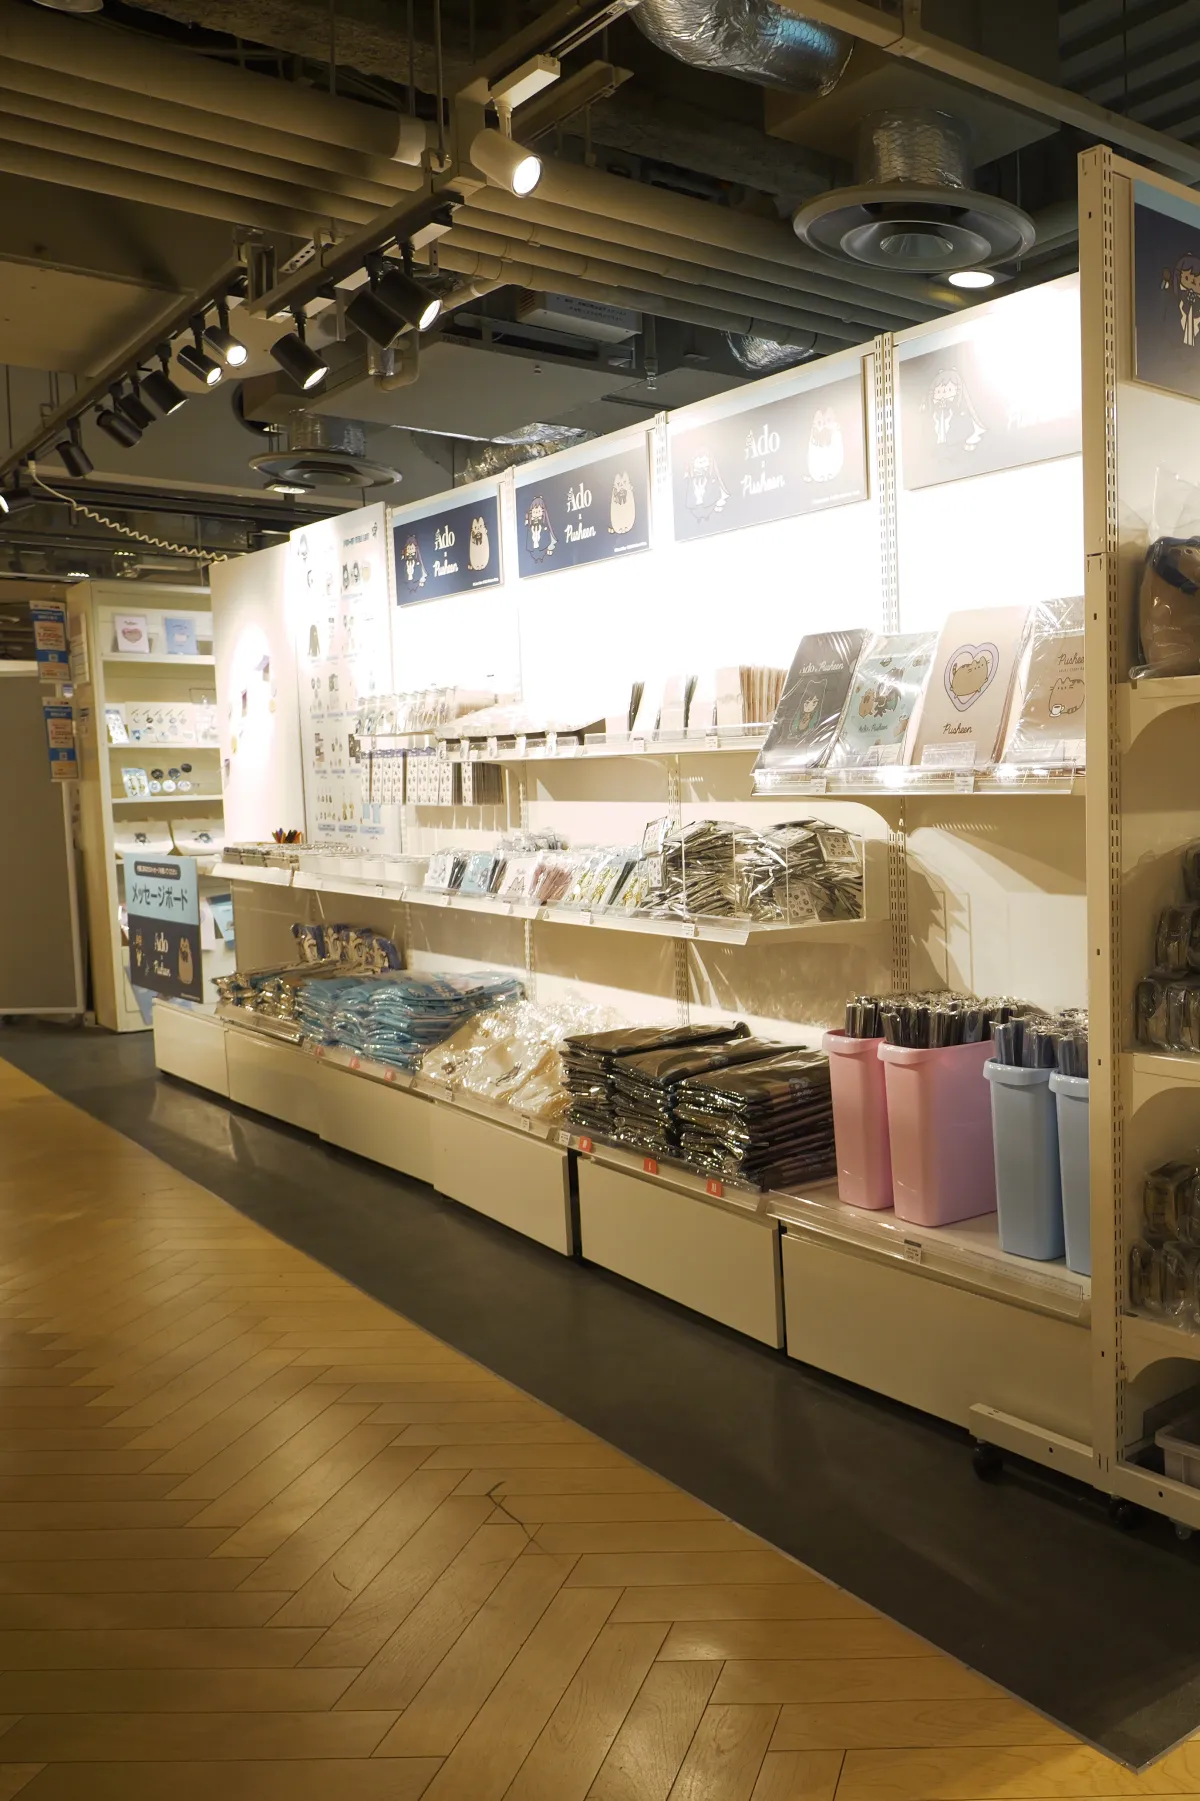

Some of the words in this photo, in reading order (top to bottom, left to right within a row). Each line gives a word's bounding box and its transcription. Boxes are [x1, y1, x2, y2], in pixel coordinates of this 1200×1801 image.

[743, 423, 780, 460] Ado
[740, 469, 785, 498] Pusheen
[565, 482, 592, 512] Ado
[434, 525, 455, 551] Ado
[564, 522, 596, 544] Pusheen
[818, 660, 845, 673] Pusheen
[1057, 652, 1085, 666] Pushee
[942, 721, 973, 736] Pusheen
[132, 883, 188, 911] メッセージボード
